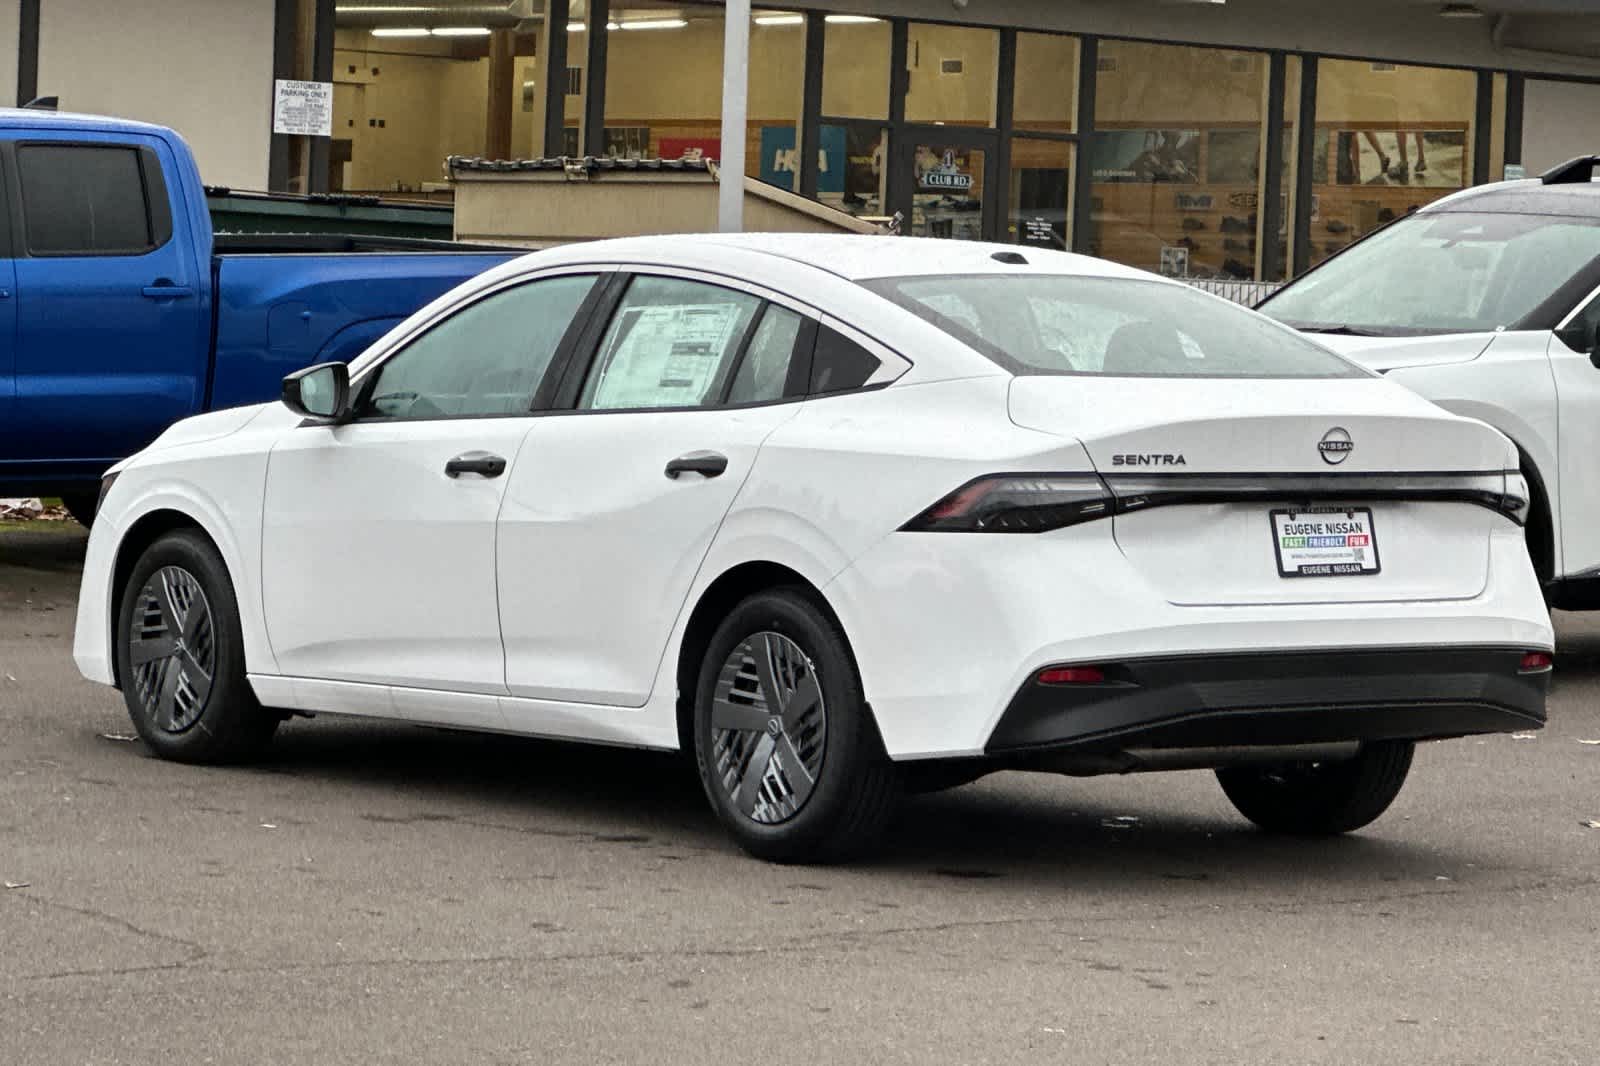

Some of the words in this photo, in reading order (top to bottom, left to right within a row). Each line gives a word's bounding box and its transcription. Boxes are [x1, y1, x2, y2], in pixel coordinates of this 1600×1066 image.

[286, 82, 321, 90] CUSTOMER
[280, 89, 310, 98] PARKING
[929, 174, 951, 186] CLUB
[1319, 441, 1353, 451] NISSAN
[1112, 454, 1187, 466] SENTRA
[1284, 524, 1324, 535] EUGENE
[1326, 523, 1363, 535] NISSAN
[1303, 566, 1331, 574] EUGENE
[1333, 564, 1361, 573] NISSAN
